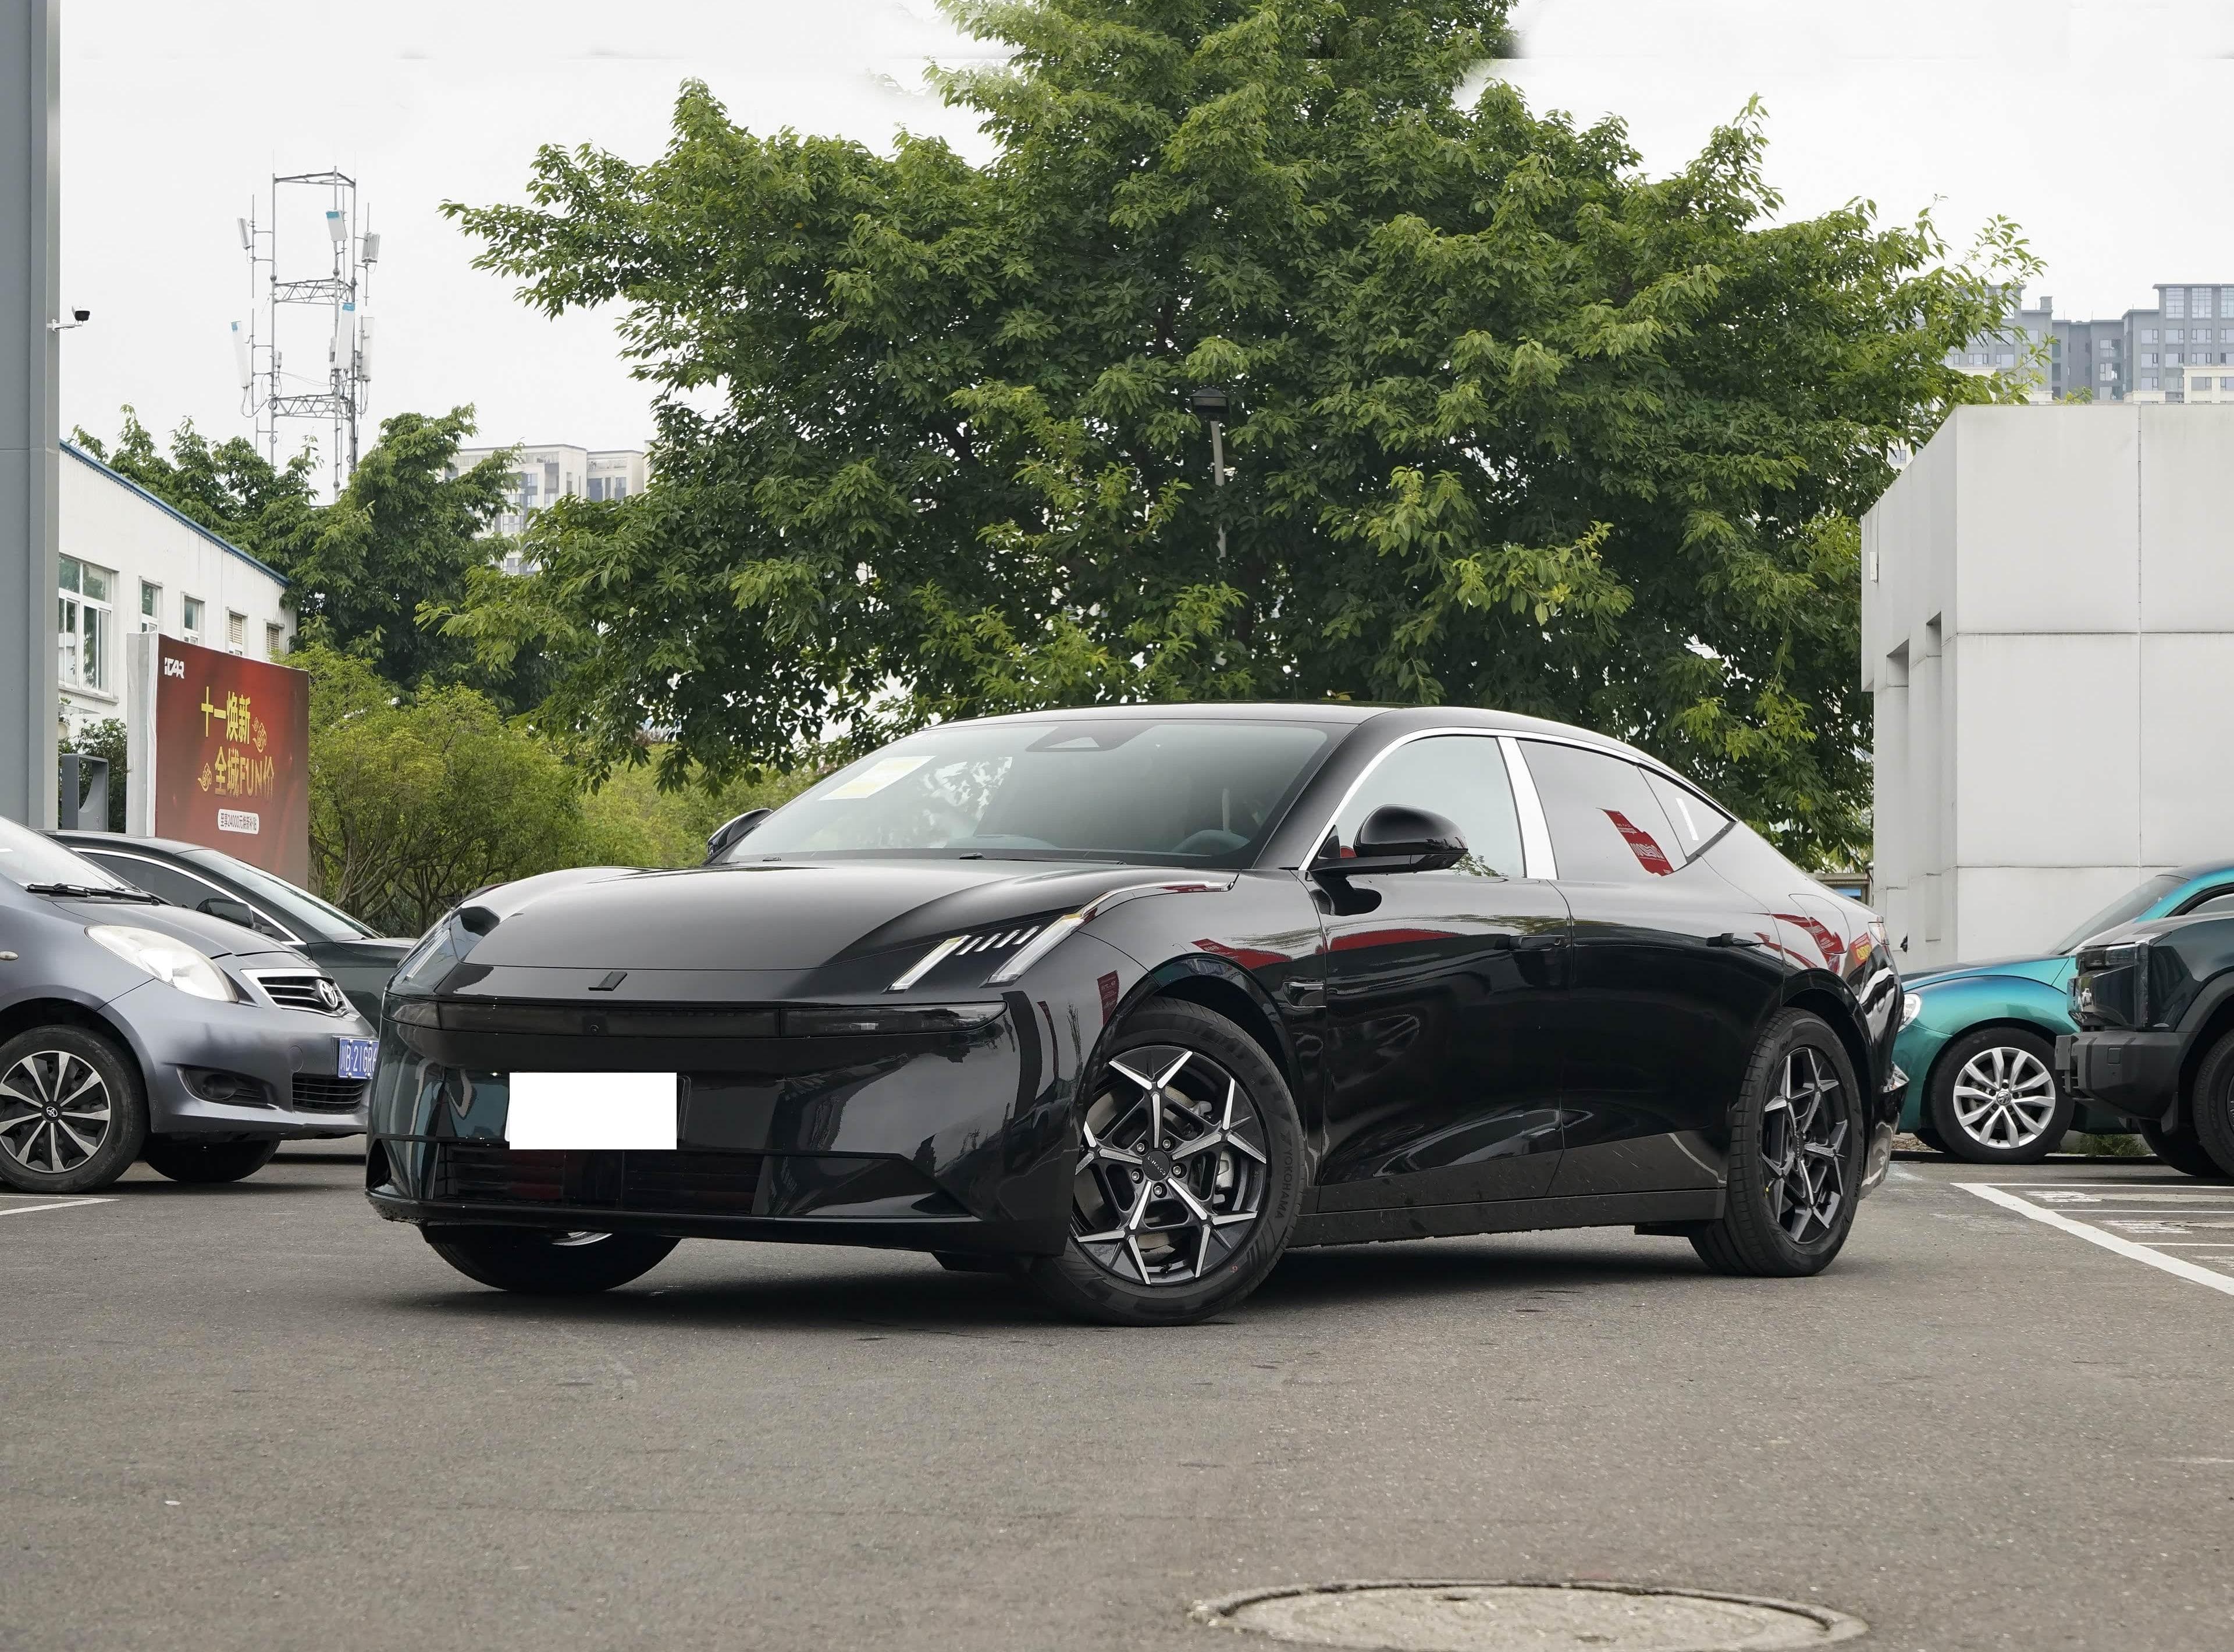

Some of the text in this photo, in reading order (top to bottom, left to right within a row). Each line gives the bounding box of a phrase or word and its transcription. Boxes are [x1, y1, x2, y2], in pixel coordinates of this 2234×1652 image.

[201, 686, 251, 744] 十一焕新
[215, 746, 274, 803] 全城FUN价
[1275, 1148, 1293, 1219] YOKOHAMA
